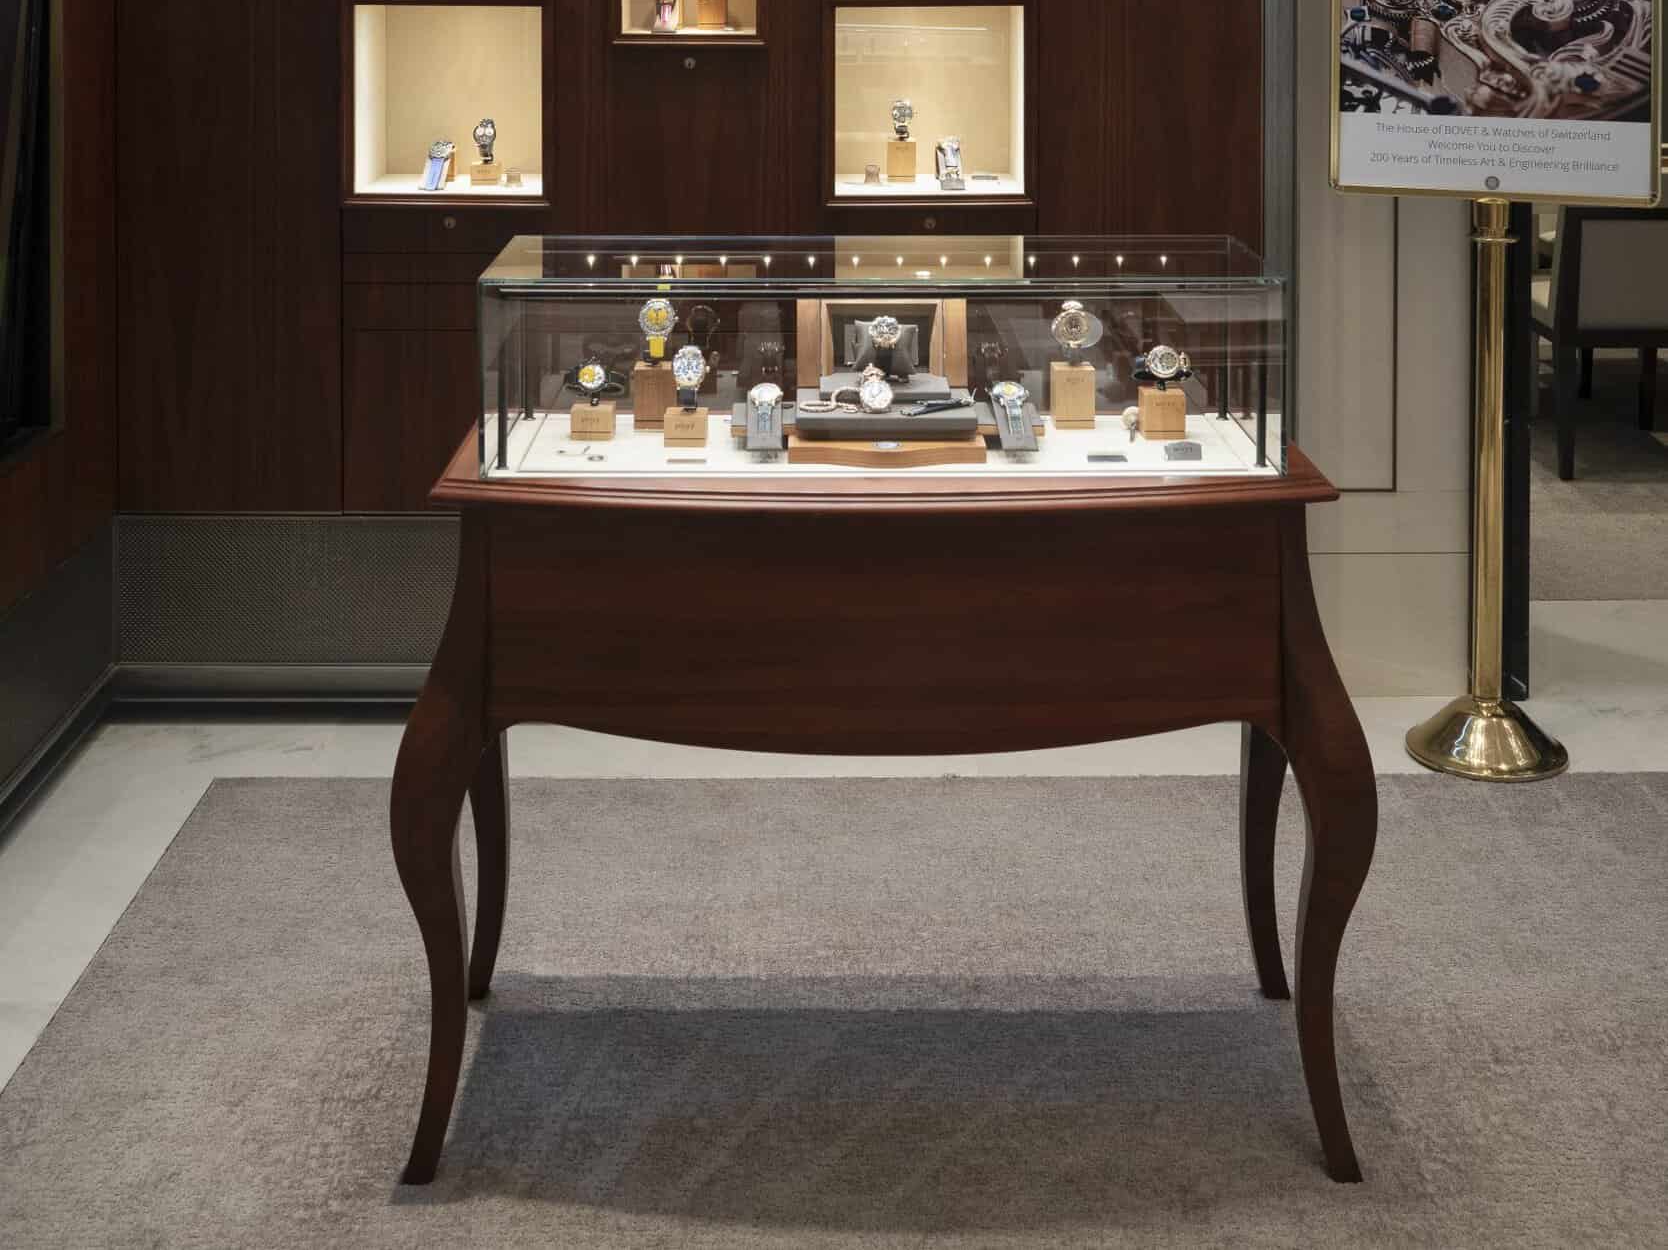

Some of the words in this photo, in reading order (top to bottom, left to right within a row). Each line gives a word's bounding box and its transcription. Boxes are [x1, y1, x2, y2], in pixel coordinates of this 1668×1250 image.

[1376, 122, 1393, 134] The
[1397, 124, 1430, 135] House
[1432, 124, 1443, 135] of
[1444, 125, 1479, 136] BOVET
[1493, 126, 1535, 138] Watches
[1539, 128, 1549, 139] of
[1551, 128, 1611, 141] Switzerland
[1428, 140, 1474, 151] Welcome
[1477, 141, 1496, 152] You
[1499, 143, 1509, 152] to
[1512, 142, 1555, 154] Discover
[1370, 152, 1389, 163] 200
[1391, 153, 1419, 165] Years
[1421, 155, 1432, 165] of
[1433, 155, 1478, 167] Timeless
[1480, 157, 1496, 167] Art
[1509, 158, 1569, 173] Engineering
[1572, 160, 1619, 173] Brilliance
